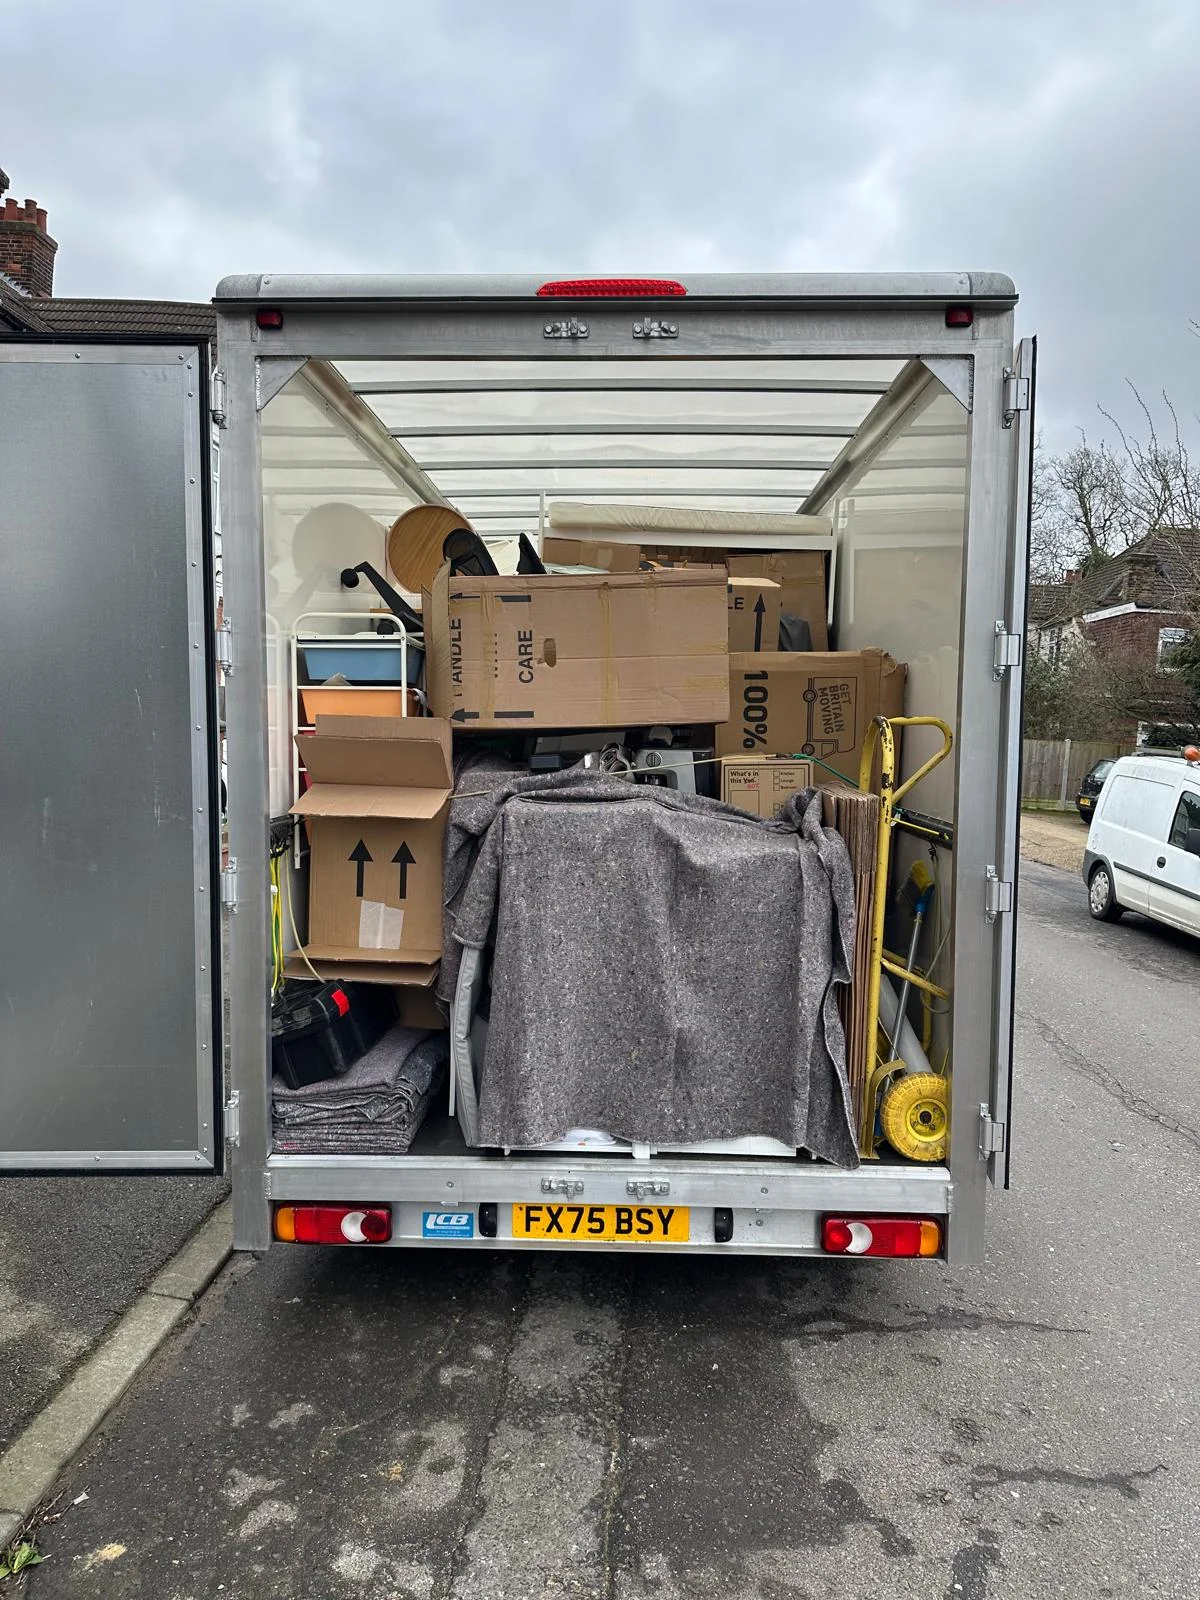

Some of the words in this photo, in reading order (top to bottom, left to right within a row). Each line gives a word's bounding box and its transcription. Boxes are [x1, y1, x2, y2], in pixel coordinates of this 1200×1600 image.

[518, 630, 534, 684] CARE
[743, 670, 768, 749] 100%
[818, 687, 834, 735] MOVING
[829, 685, 845, 733] BRITAIN
[840, 683, 852, 705] GET
[525, 1206, 605, 1234] FX75
[615, 1207, 675, 1236] BSY
